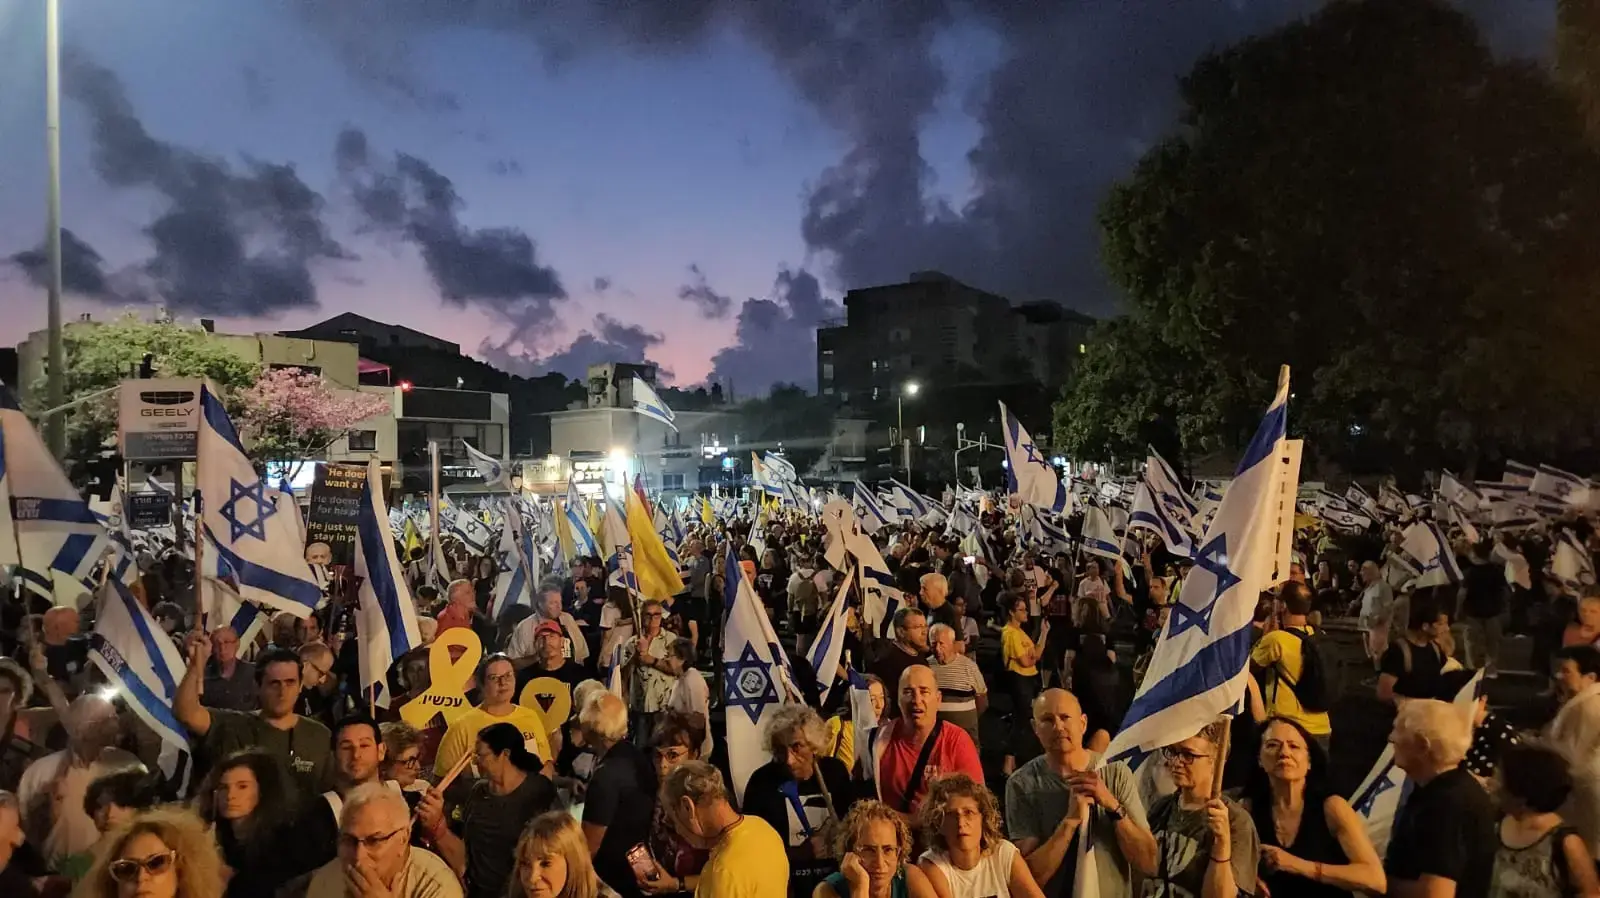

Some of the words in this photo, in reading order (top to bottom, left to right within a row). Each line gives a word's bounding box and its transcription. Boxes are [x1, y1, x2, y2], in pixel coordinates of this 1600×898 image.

[141, 408, 194, 417] GEELY
[329, 468, 343, 477] He
[325, 479, 350, 488] want
[314, 495, 327, 503] He
[317, 504, 332, 514] for
[334, 505, 348, 515] his
[308, 522, 322, 530] He
[323, 522, 343, 532] just
[313, 532, 334, 543] stay
[336, 532, 346, 541] in
